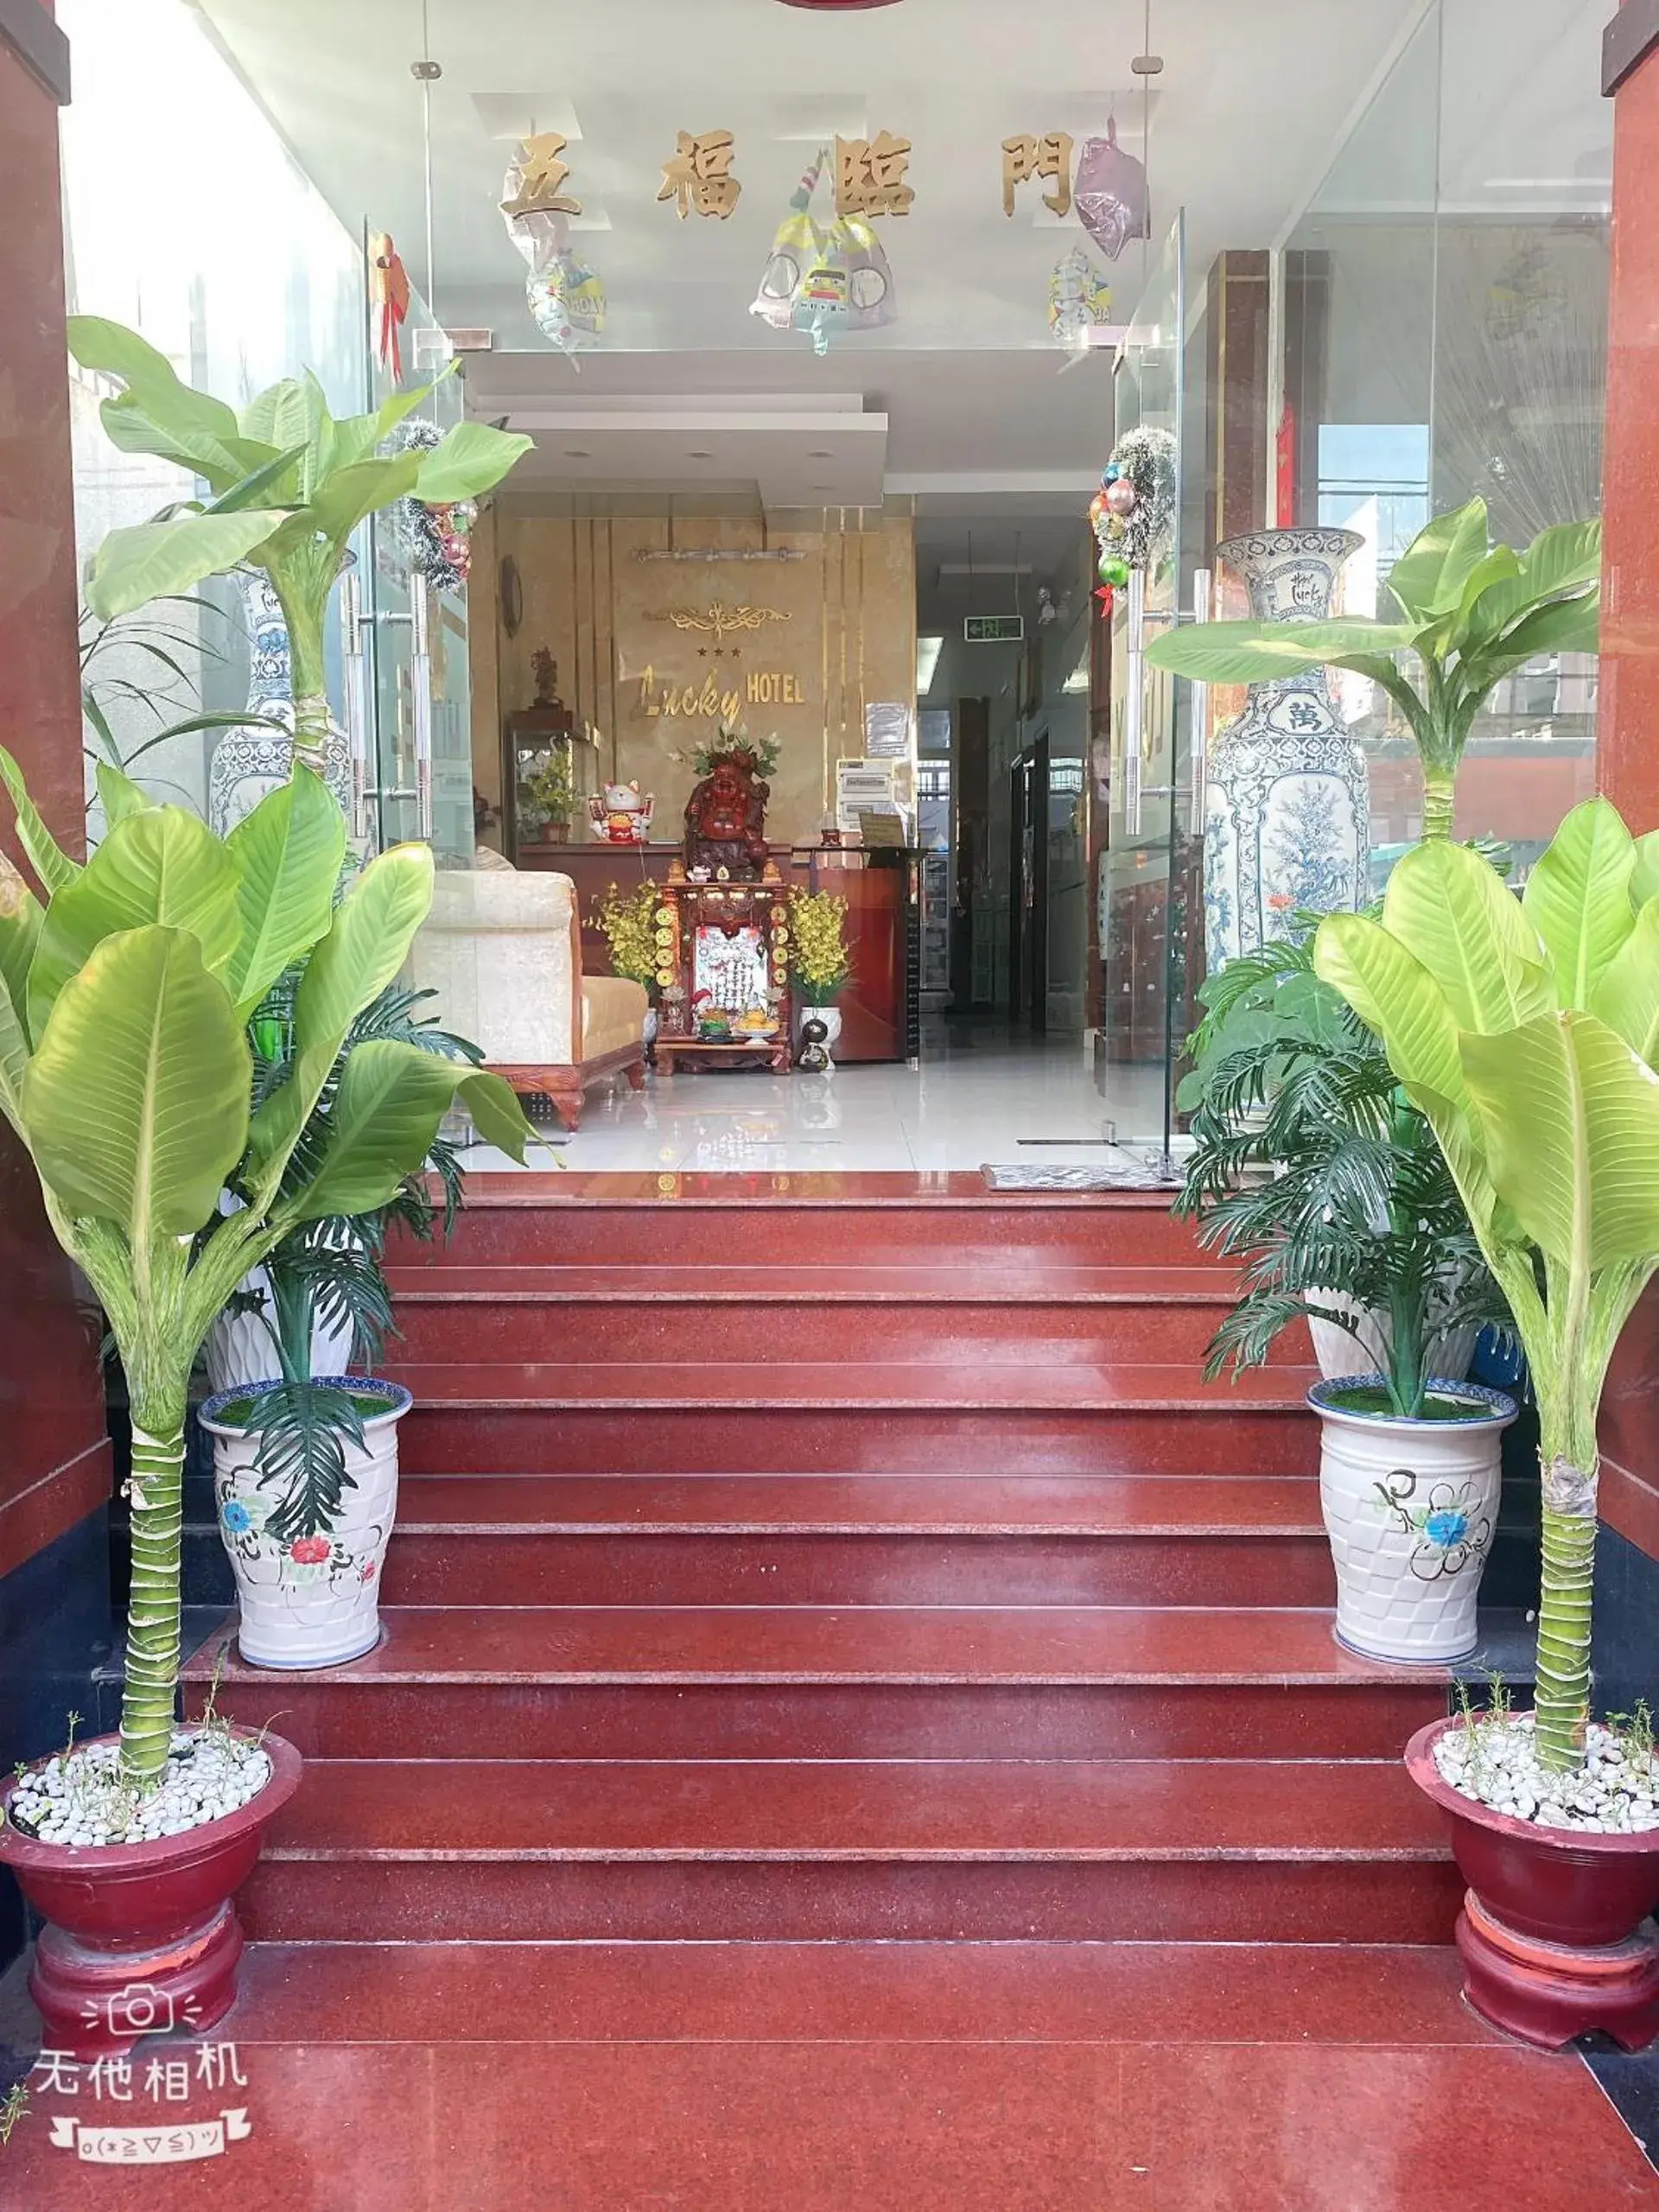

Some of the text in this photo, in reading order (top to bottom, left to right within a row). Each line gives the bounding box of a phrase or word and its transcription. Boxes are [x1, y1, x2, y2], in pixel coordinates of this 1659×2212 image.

[499, 129, 1074, 219] 五福臨門
[639, 664, 805, 728] Lucky HOTEL
